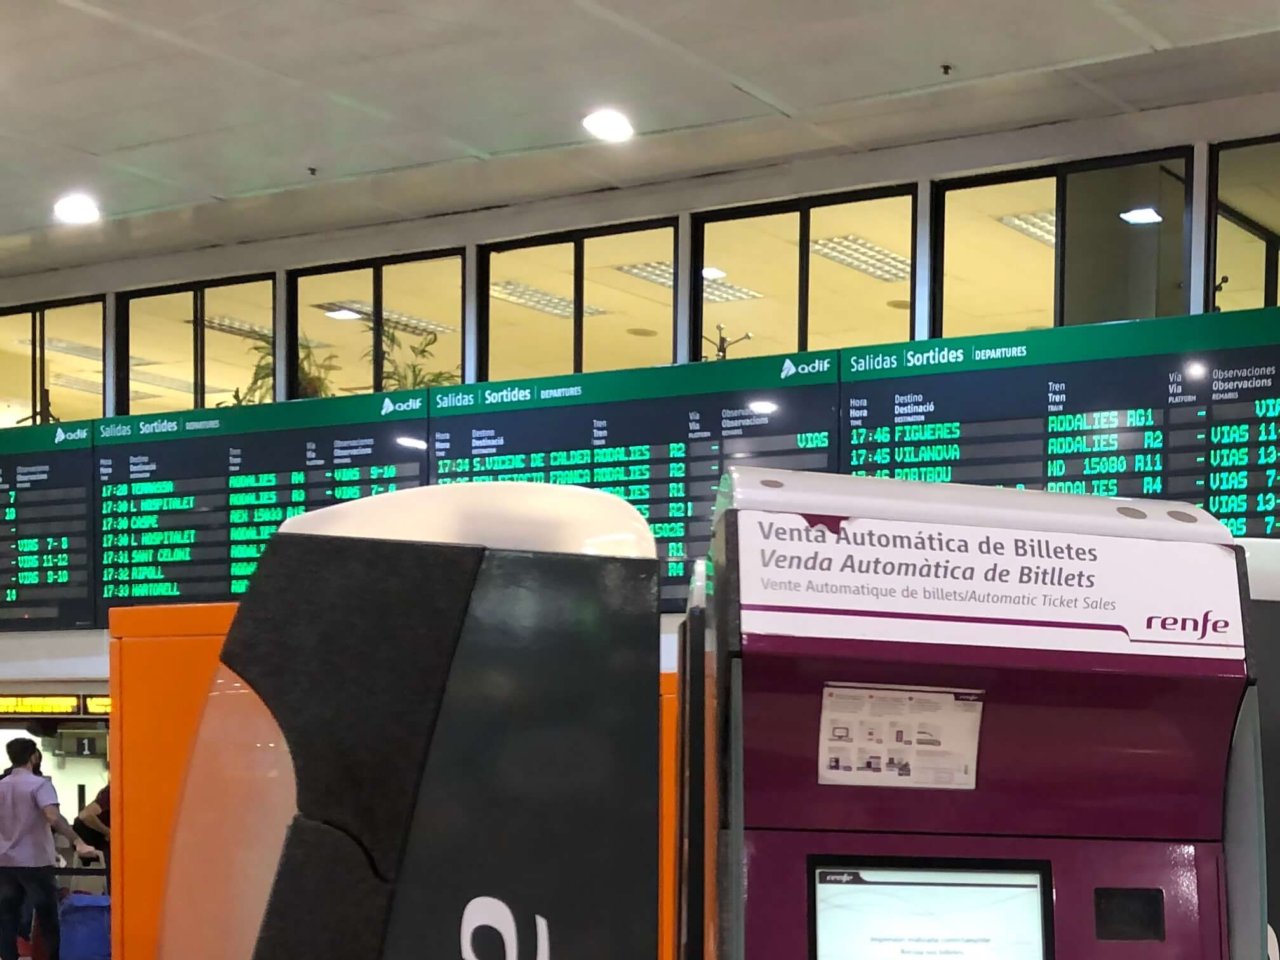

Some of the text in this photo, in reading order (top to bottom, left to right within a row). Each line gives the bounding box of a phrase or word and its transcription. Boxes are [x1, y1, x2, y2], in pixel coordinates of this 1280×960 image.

[797, 359, 831, 374] adif
[850, 346, 1027, 372] Salidas Sortides DEPARTURES
[1212, 365, 1276, 380] Observaciones
[1048, 382, 1066, 391] Tren
[1212, 377, 1272, 392] Observacions
[435, 393, 475, 408] Salidas
[485, 387, 532, 404] Sortides
[849, 399, 868, 408] Hora
[894, 394, 923, 405] Destino
[1048, 392, 1067, 402] Tren
[849, 408, 868, 418] Hora
[894, 402, 935, 415] Destinació
[99, 420, 178, 439] Salidas Sortides
[850, 427, 891, 445] 17:46
[894, 422, 961, 442] FIGUERES
[1048, 410, 1119, 432] RODALIES
[796, 431, 829, 450] VIAS
[850, 448, 891, 466] 17:45
[894, 444, 961, 463] VILANOVA
[1048, 433, 1119, 455] RODALIES
[1144, 431, 1164, 449] R2
[1210, 424, 1249, 444] VIAS
[1210, 447, 1249, 467] VIAS
[1143, 475, 1163, 494] R4
[1210, 470, 1248, 491] VIAS
[1209, 494, 1248, 514] VIAS
[758, 520, 1098, 563] Venta Automática de Billetes
[760, 548, 1096, 589] Venda Automàtica de Bitllets
[762, 577, 1117, 612] Vente Automatique de billets/Automatic Ticket Sales
[1145, 610, 1230, 641] renfe
[82, 738, 91, 755] 1
